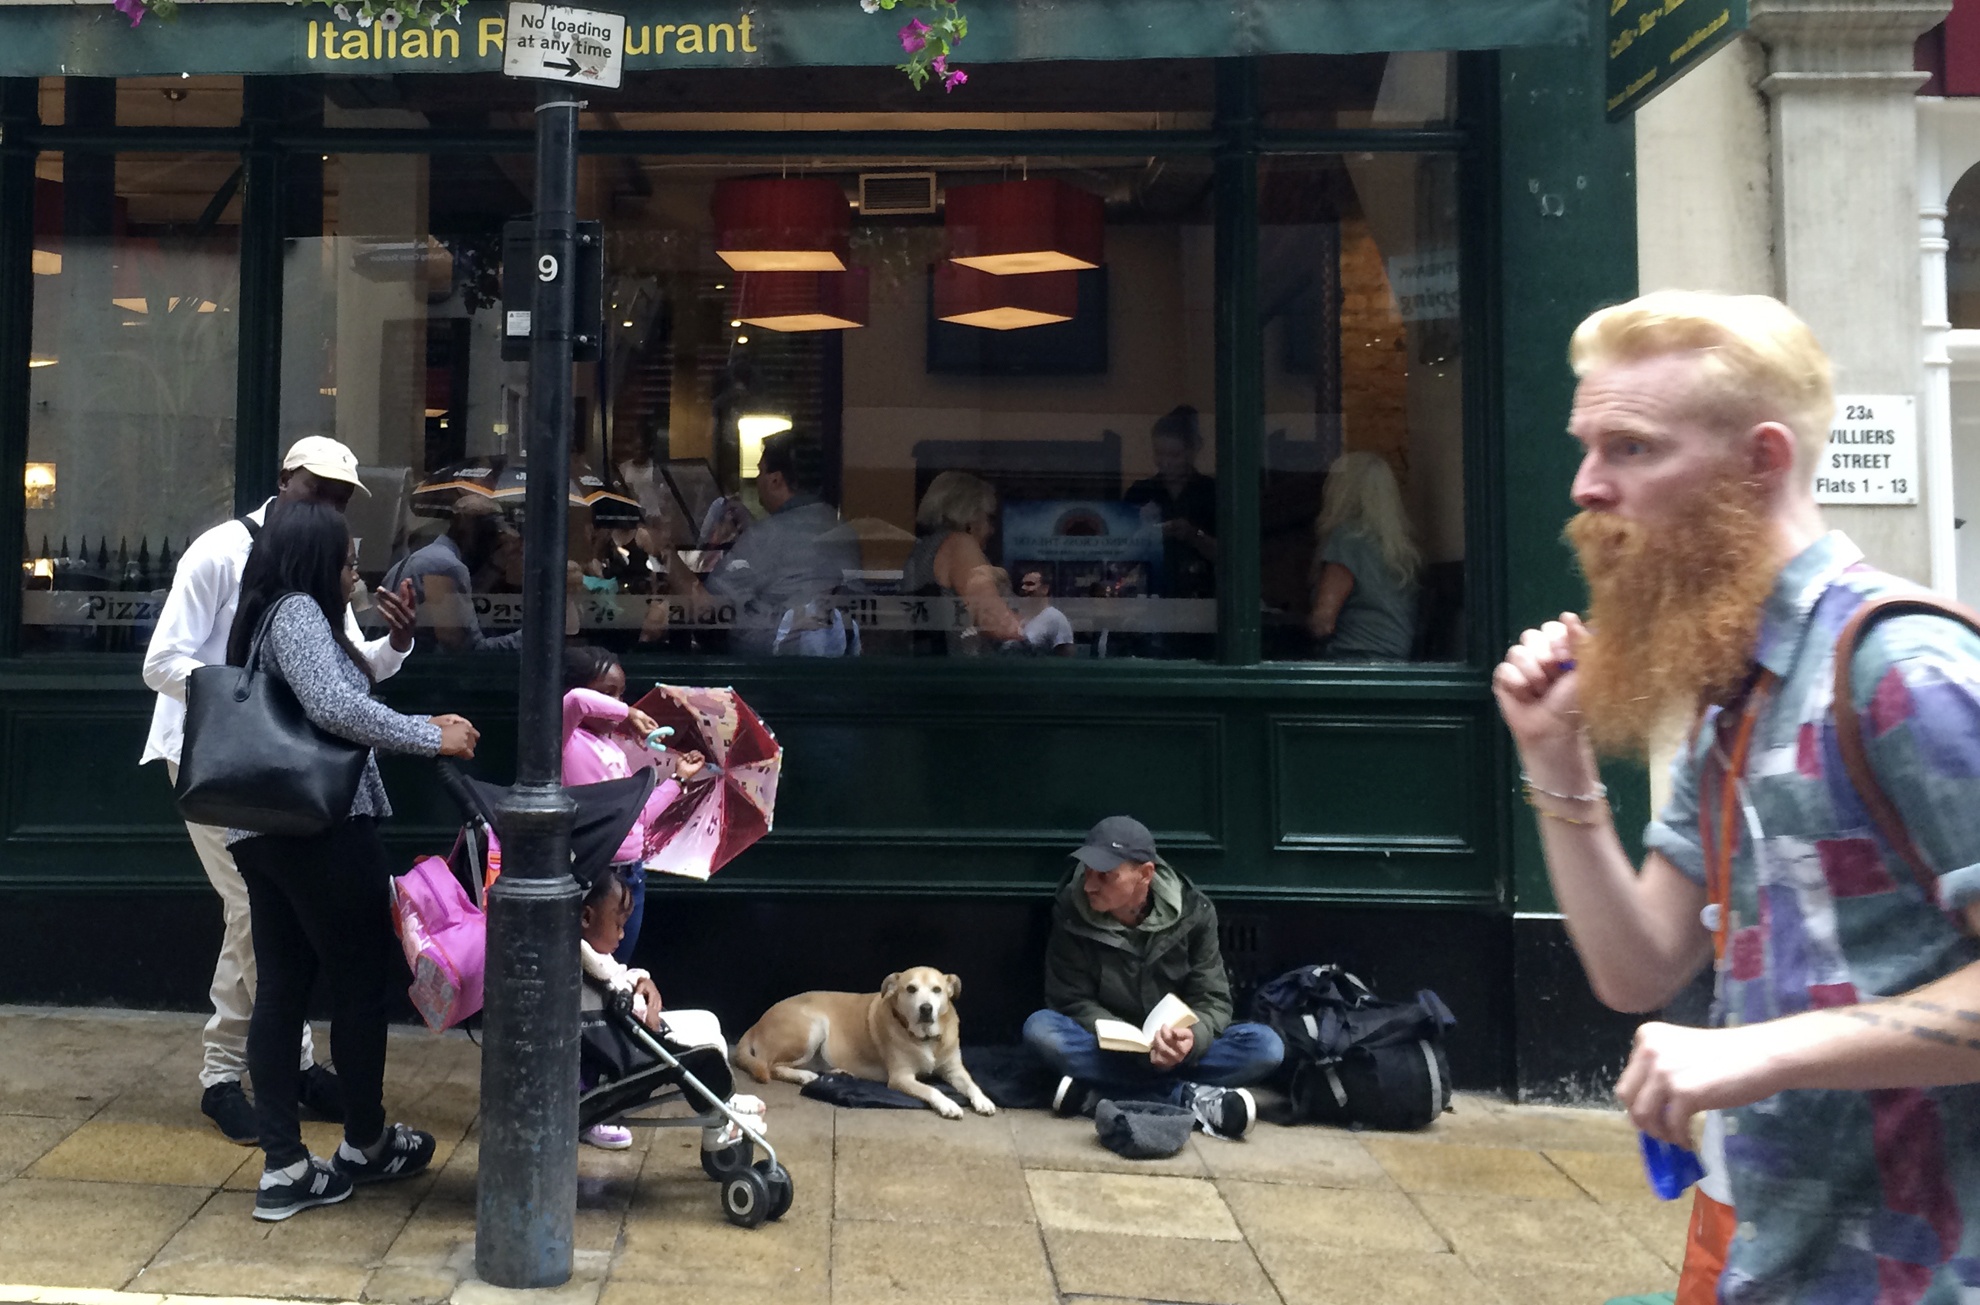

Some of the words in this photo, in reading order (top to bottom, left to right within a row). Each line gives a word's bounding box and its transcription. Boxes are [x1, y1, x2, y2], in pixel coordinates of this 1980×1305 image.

[308, 20, 460, 60] Italian
[478, 14, 758, 57] Rurant
[521, 14, 544, 29] No
[551, 17, 611, 41] loading
[517, 35, 535, 48] at
[540, 38, 570, 54] any
[576, 41, 612, 58] time
[538, 254, 559, 282] 9
[1846, 405, 1874, 420] 23A
[1832, 453, 1891, 469] STREET
[1816, 478, 1856, 493] Flats
[1862, 478, 1869, 493] 1
[1891, 478, 1908, 494] 13
[472, 596, 522, 624] Pas
[309, 1172, 330, 1195] N
